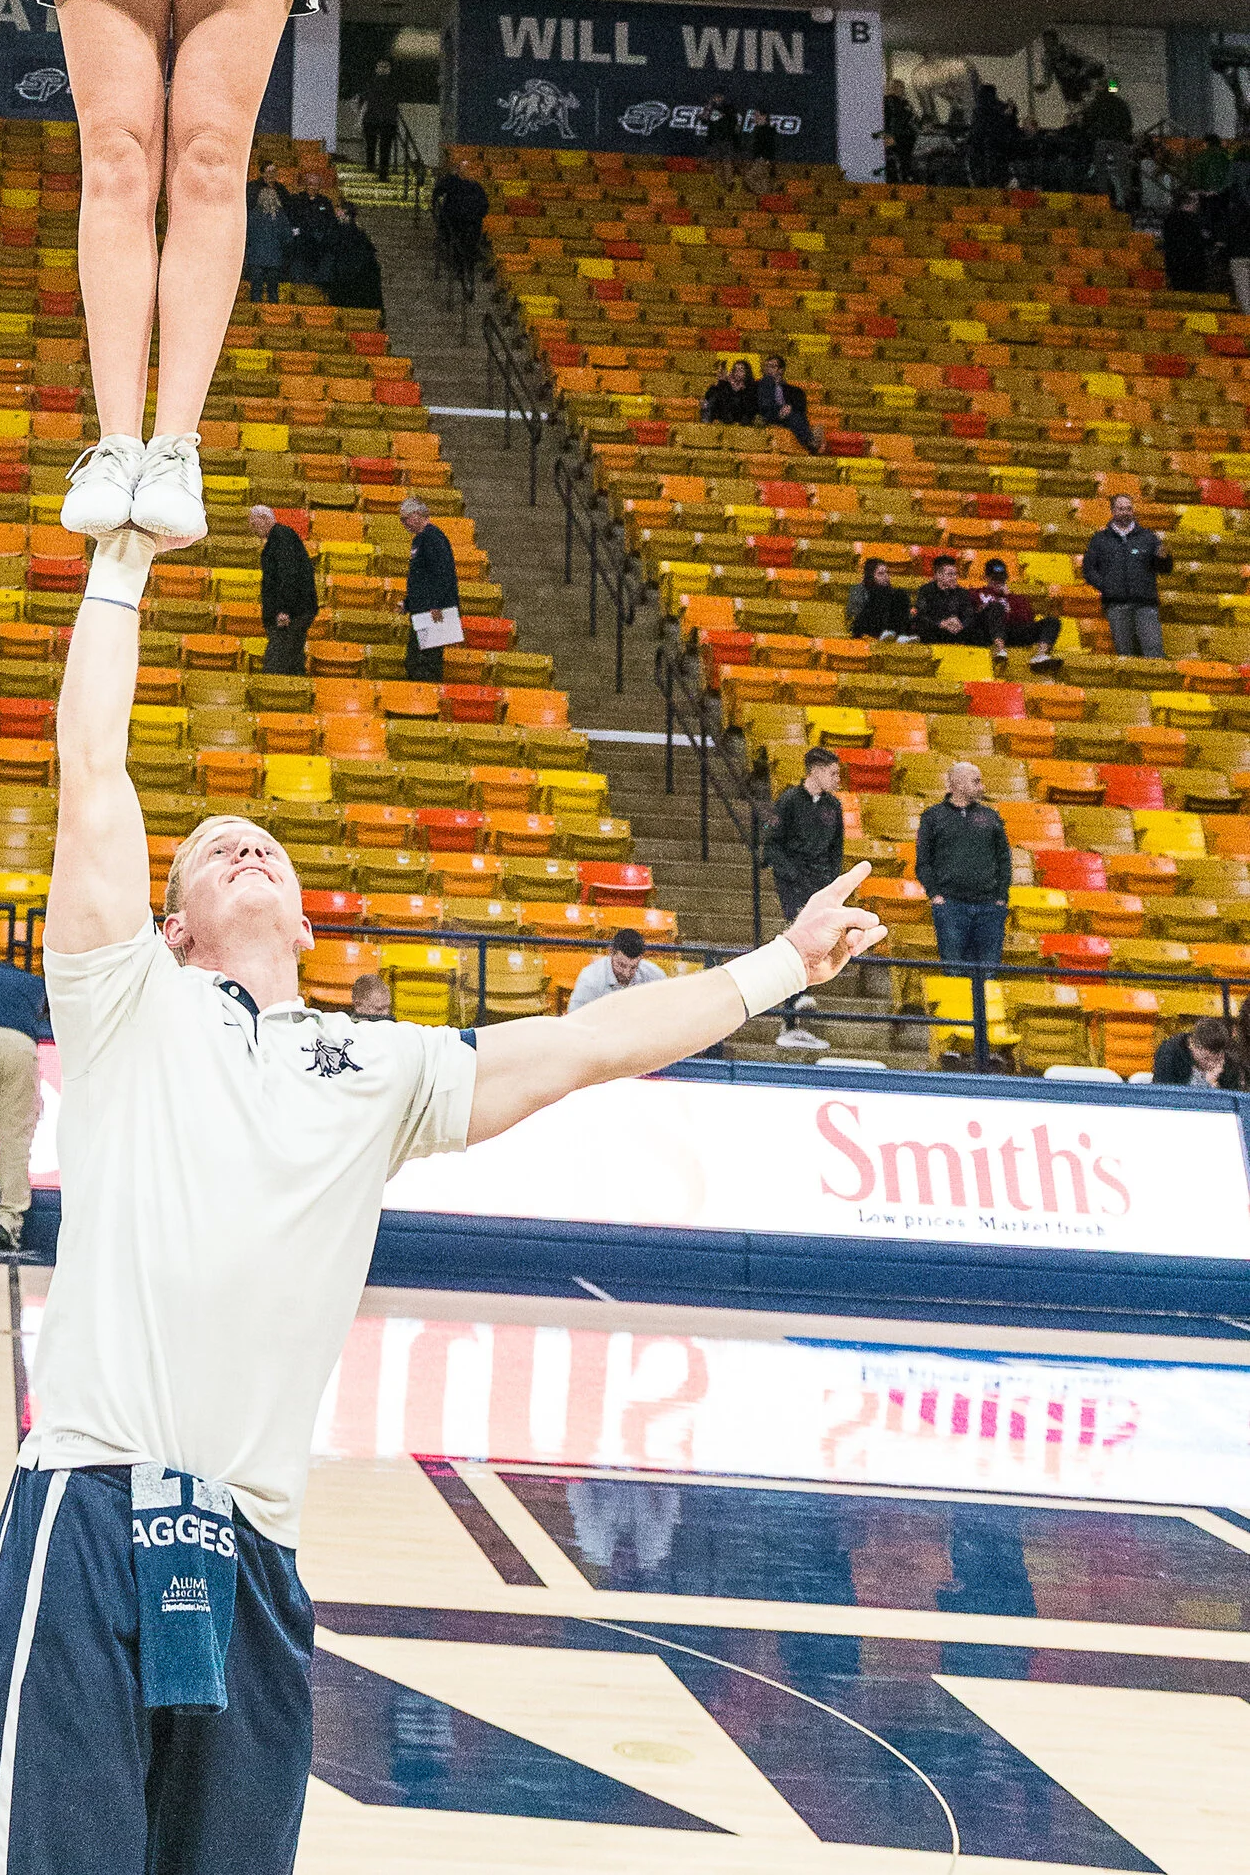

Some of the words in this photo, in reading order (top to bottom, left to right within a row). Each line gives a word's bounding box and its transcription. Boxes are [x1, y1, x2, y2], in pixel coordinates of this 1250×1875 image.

[499, 14, 647, 65] WILL
[682, 24, 805, 75] WIN
[852, 20, 871, 44] B
[815, 1100, 1132, 1217] Smith's
[858, 1208, 897, 1224] Low
